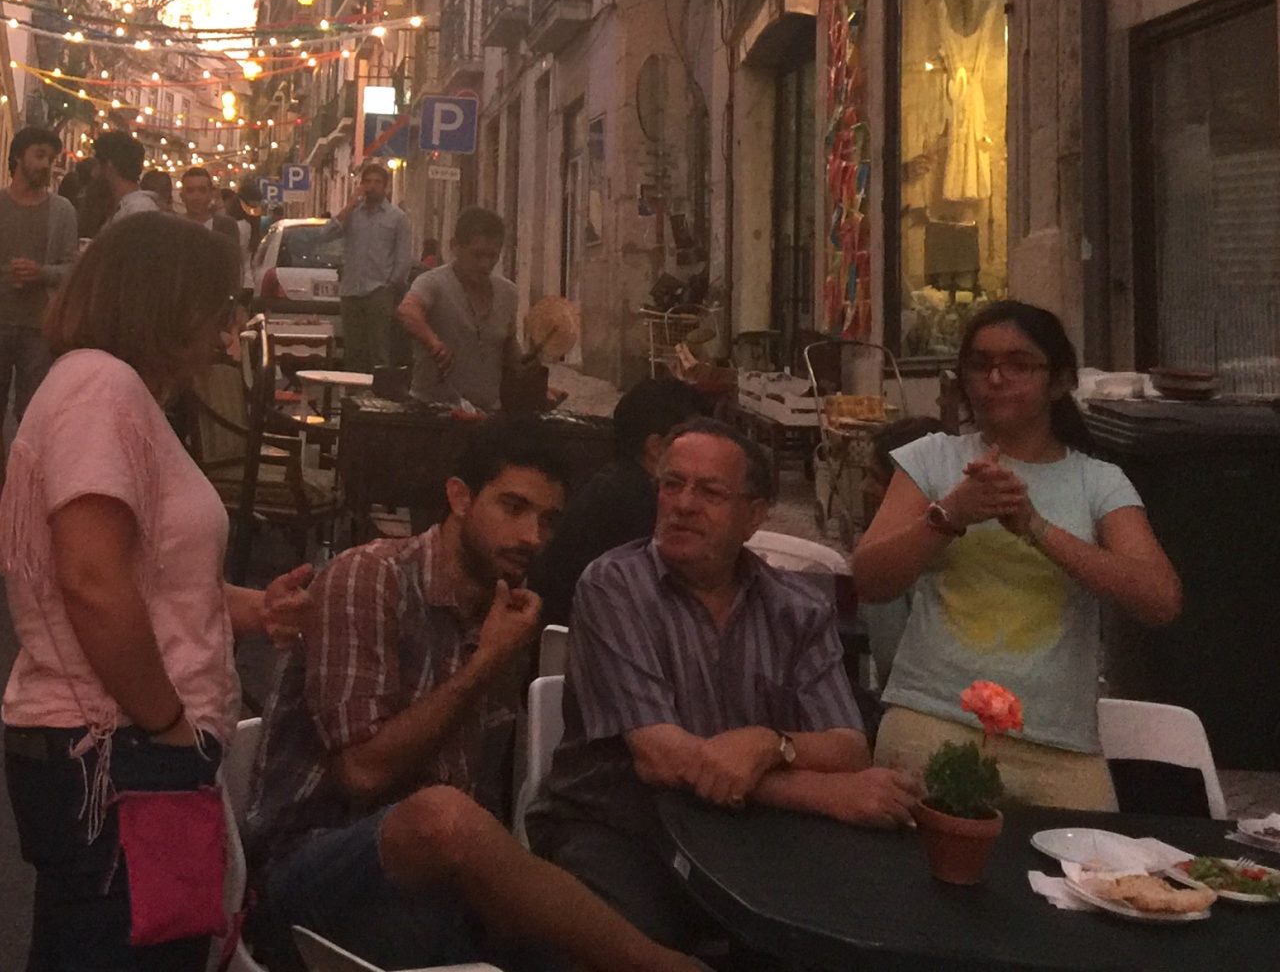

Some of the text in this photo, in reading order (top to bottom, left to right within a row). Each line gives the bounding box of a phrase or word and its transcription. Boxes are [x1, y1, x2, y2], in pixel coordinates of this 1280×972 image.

[431, 102, 464, 146] P
[288, 166, 304, 189] P
[266, 185, 279, 200] P
